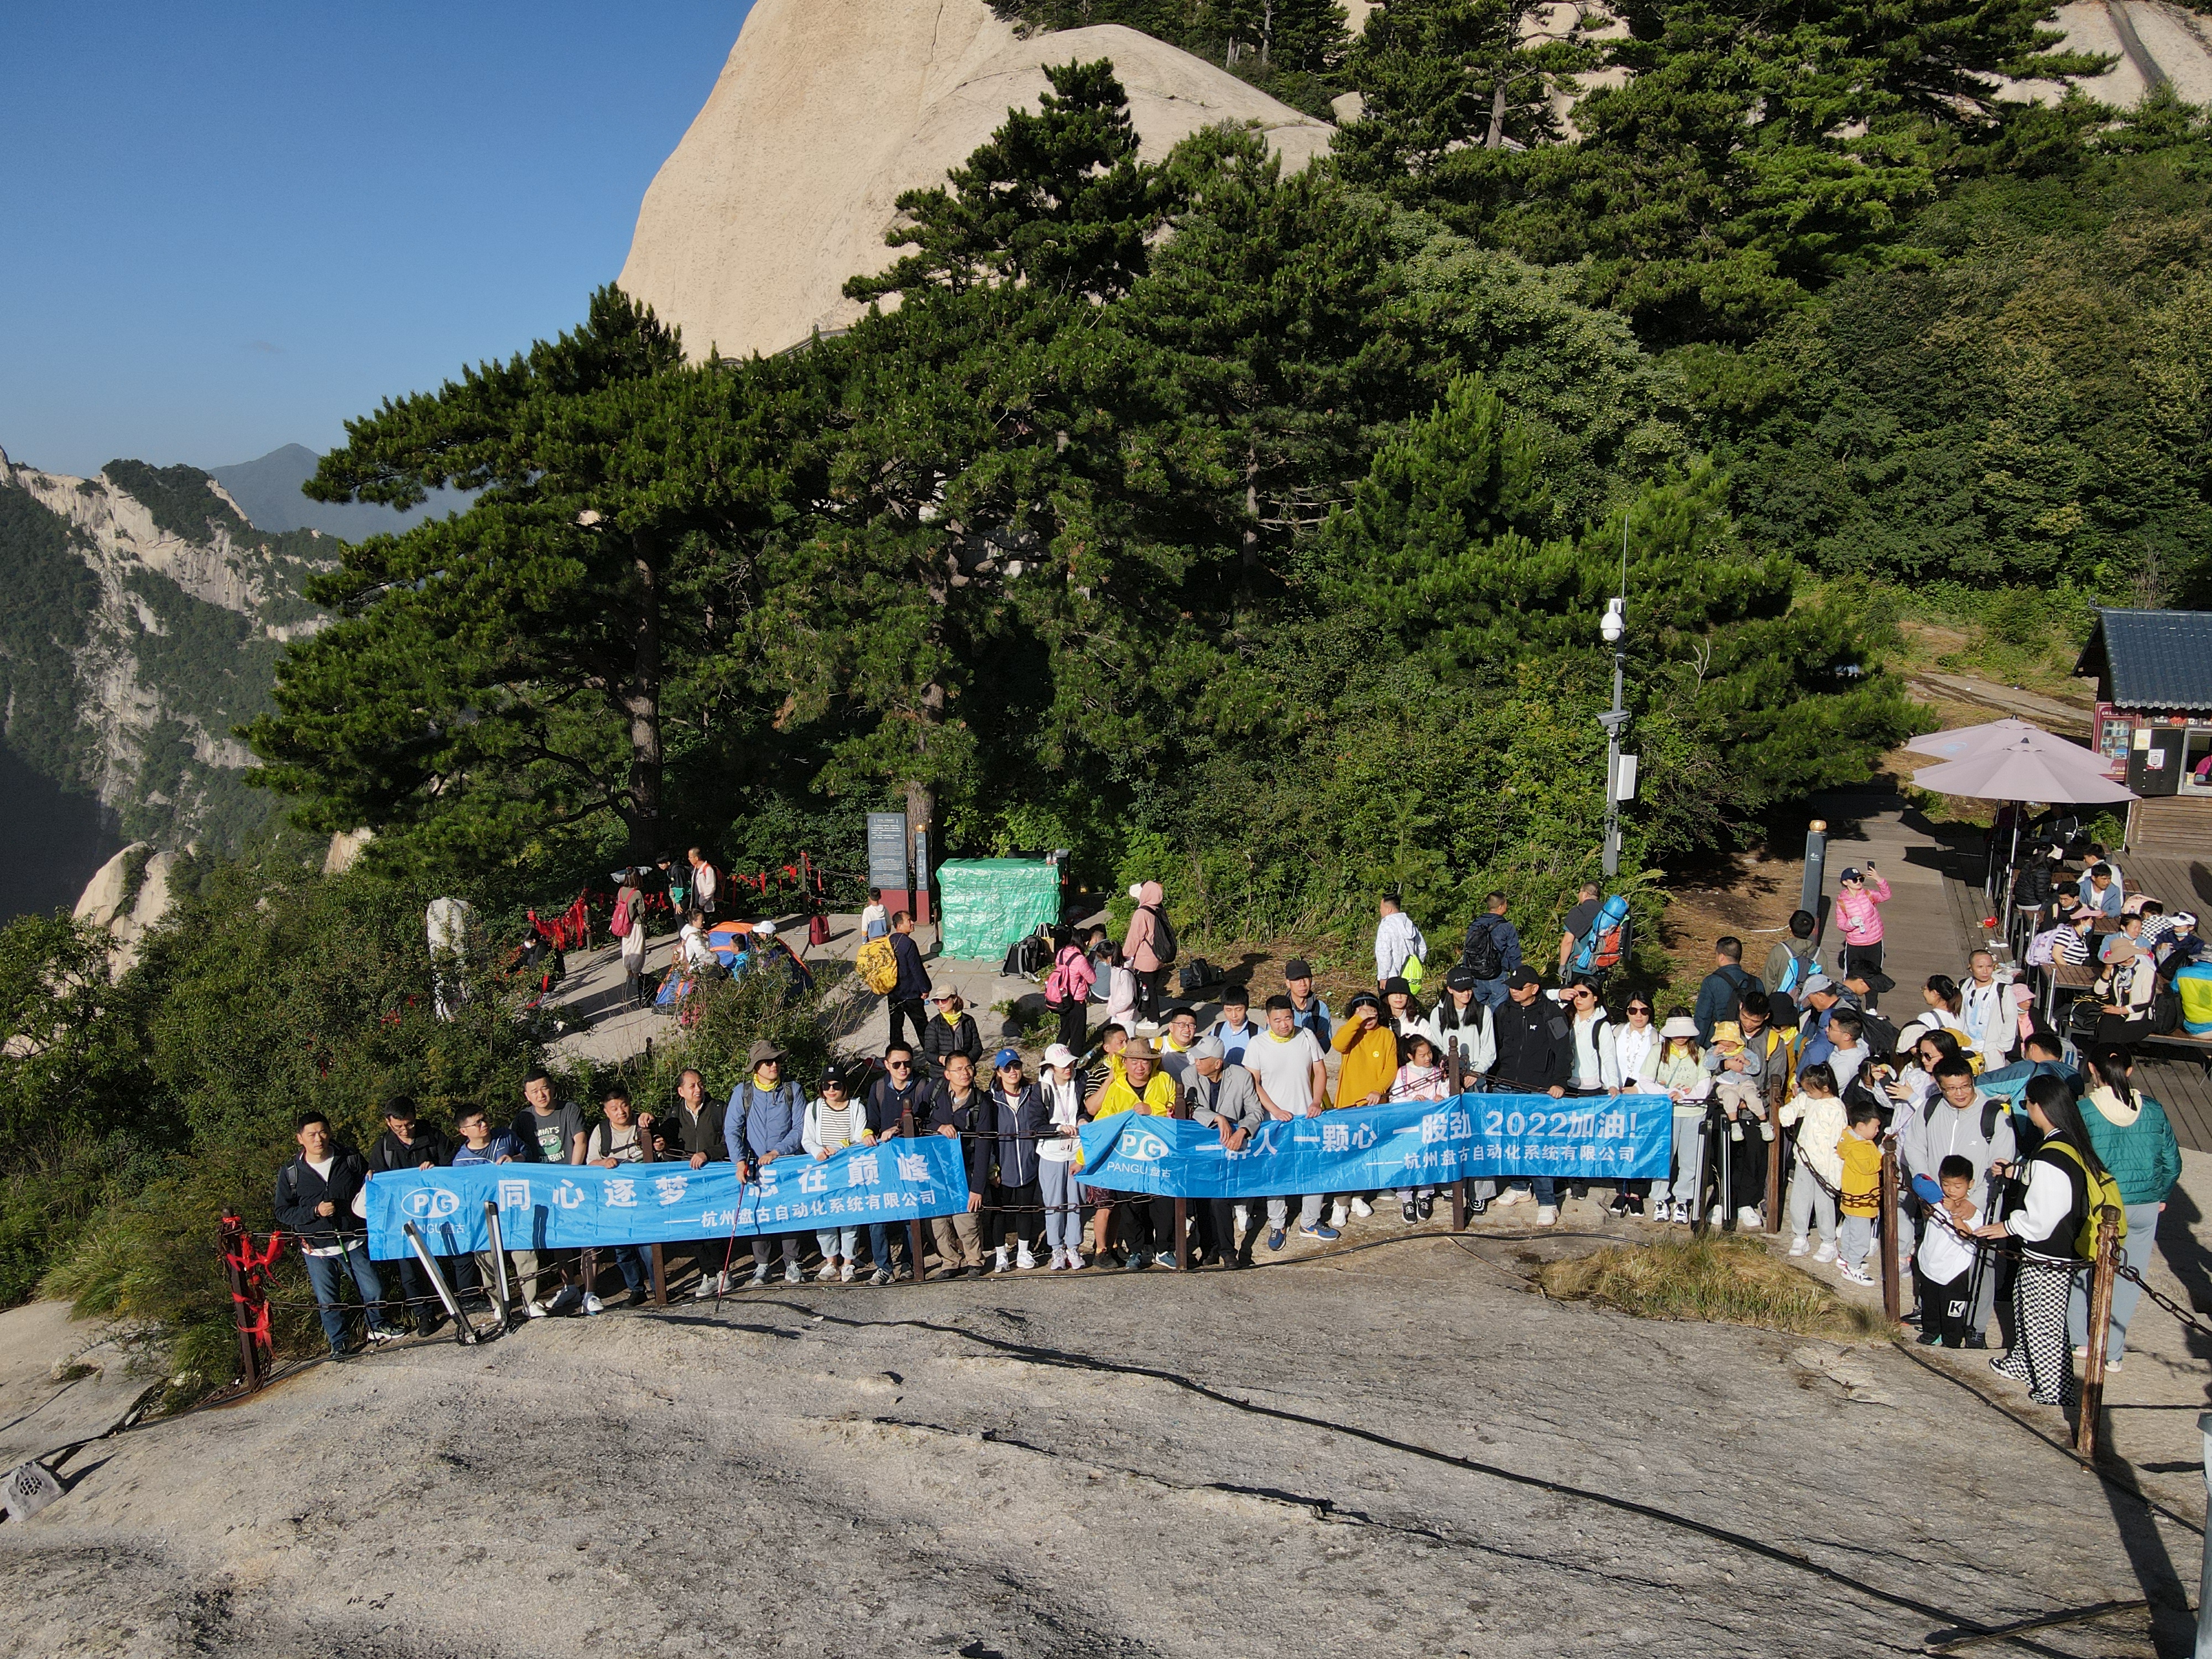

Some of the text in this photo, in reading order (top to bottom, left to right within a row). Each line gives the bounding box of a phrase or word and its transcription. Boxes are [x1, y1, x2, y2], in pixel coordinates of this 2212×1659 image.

[1293, 1122, 1377, 1152] 一颗心
[1392, 1109, 1473, 1145] 一股劲
[1107, 1161, 1172, 1178] PANGU 盘古
[402, 1223, 442, 1236] PNGU
[1950, 1302, 1964, 1313] K
